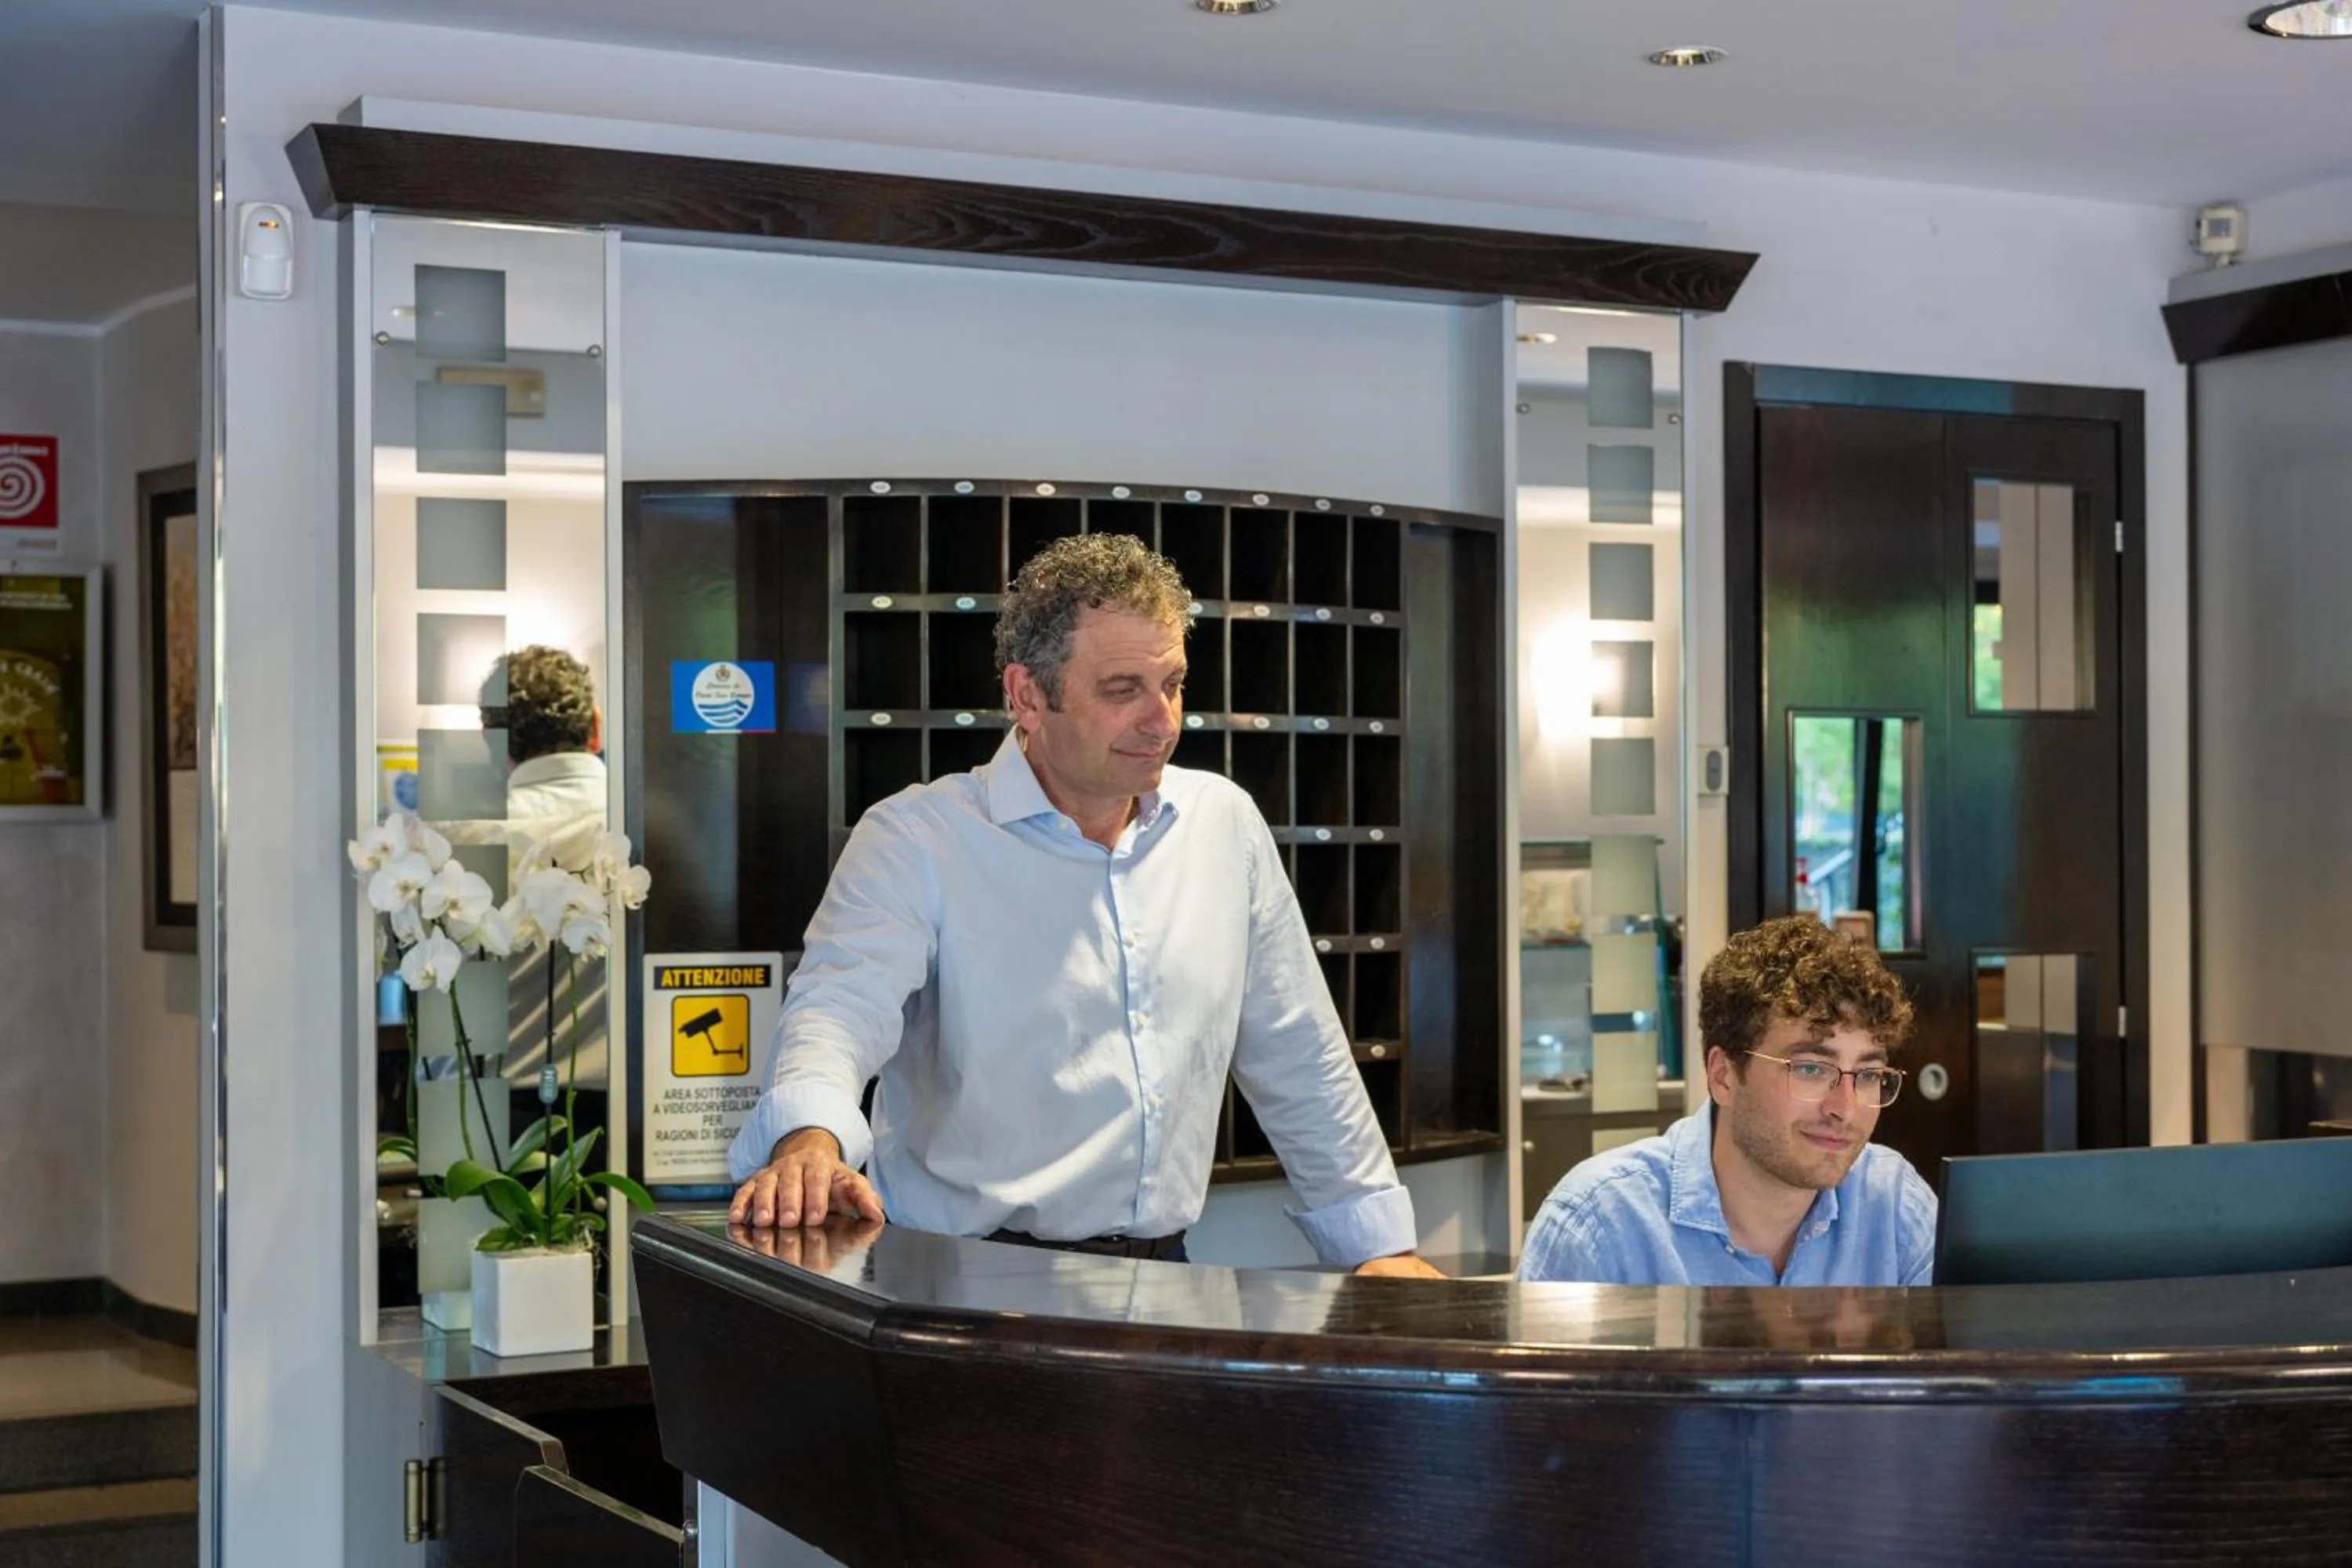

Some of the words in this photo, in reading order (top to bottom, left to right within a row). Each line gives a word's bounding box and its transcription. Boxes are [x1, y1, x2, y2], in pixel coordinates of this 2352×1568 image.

[662, 967, 765, 987] ATTENZIONE
[664, 1088, 691, 1100] AREA
[694, 1087, 761, 1099] SOTTOPOSTA
[653, 1103, 662, 1115] A
[702, 1114, 723, 1126] PER
[655, 1130, 699, 1142] RAGIONI
[700, 1128, 711, 1141] DI
